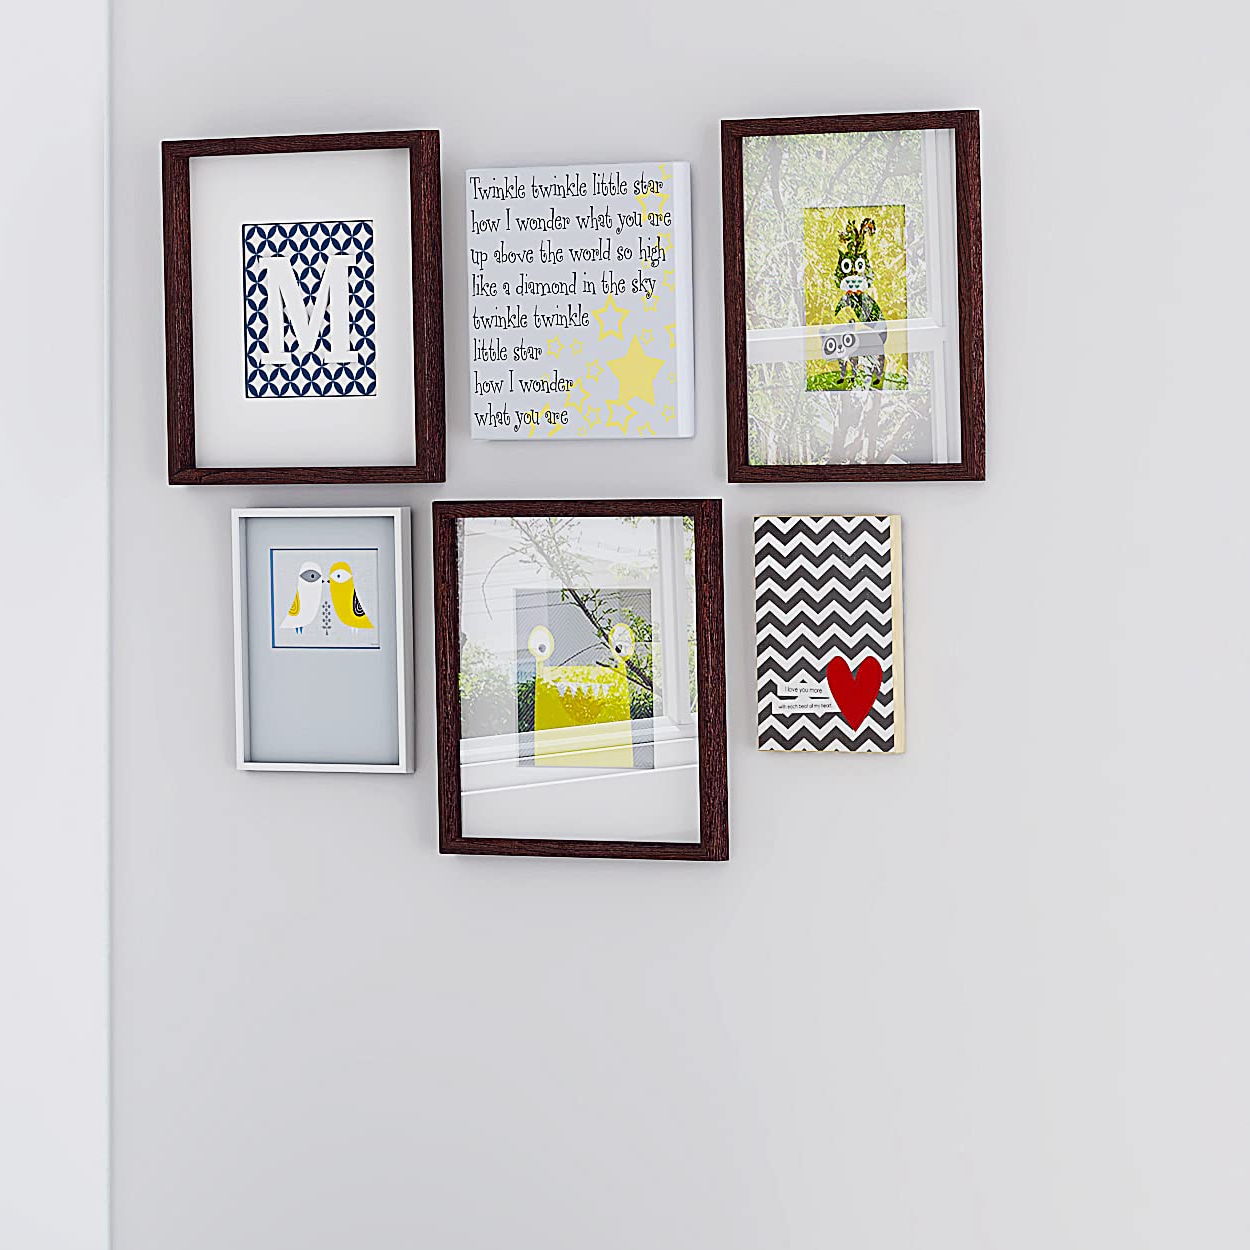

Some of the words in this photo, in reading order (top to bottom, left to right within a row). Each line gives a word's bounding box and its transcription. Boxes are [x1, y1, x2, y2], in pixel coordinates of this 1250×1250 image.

[470, 176, 526, 200] Twinkle
[531, 173, 587, 198] twinkle
[592, 172, 628, 196] little
[633, 171, 664, 195] star
[471, 210, 501, 234] how
[506, 208, 511, 230] I
[516, 208, 570, 232] wonder
[576, 206, 613, 230] what
[616, 211, 643, 234] you
[648, 212, 672, 226] are
[471, 248, 488, 270] up
[494, 240, 534, 264] above
[539, 240, 564, 264] the
[569, 238, 611, 262] world
[616, 245, 632, 260] so
[638, 236, 666, 268] high
[472, 274, 498, 297] like
[503, 282, 510, 296] a
[516, 272, 577, 296] diamond
[583, 272, 596, 295] in
[601, 270, 626, 296] the
[632, 270, 656, 299] sky
[258, 255, 358, 366] M
[473, 305, 528, 330] twinkle
[534, 304, 590, 328] twinkle
[474, 338, 508, 362] little
[514, 338, 542, 361] star
[474, 370, 504, 395] how
[509, 370, 514, 393] I
[519, 370, 574, 393] wonder
[474, 402, 510, 426] what
[514, 409, 540, 432] you
[544, 410, 569, 425] are
